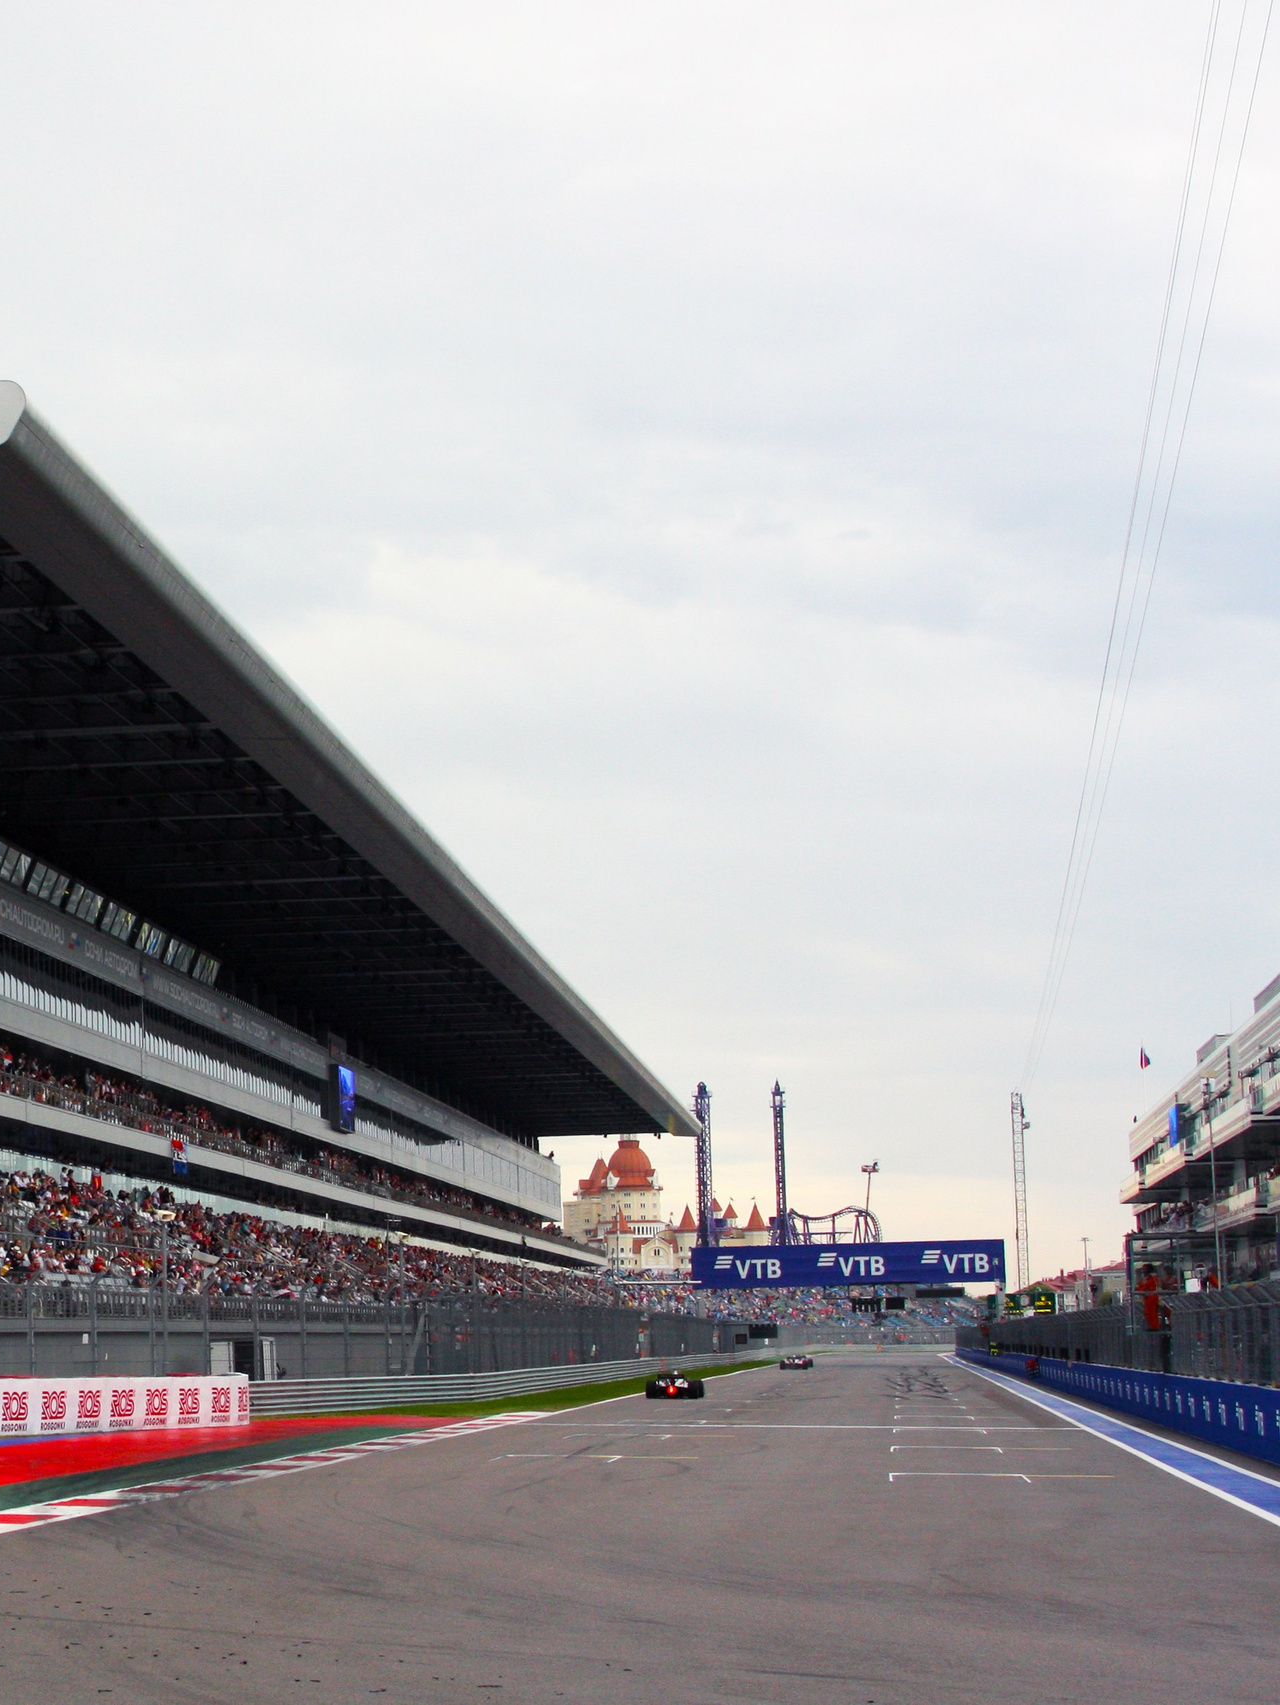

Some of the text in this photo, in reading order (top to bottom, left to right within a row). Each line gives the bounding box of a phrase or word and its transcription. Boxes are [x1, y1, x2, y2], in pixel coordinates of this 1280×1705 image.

[734, 1259, 781, 1279] VTB
[838, 1256, 885, 1277] VTB
[942, 1253, 989, 1274] VTB
[1, 1391, 29, 1422] ROS
[40, 1389, 68, 1421] ROS
[77, 1389, 103, 1419] ROS
[109, 1388, 136, 1418] ROS
[145, 1387, 170, 1417] ROS
[178, 1387, 201, 1416] ROS
[1, 1424, 27, 1432] ROSGONKI
